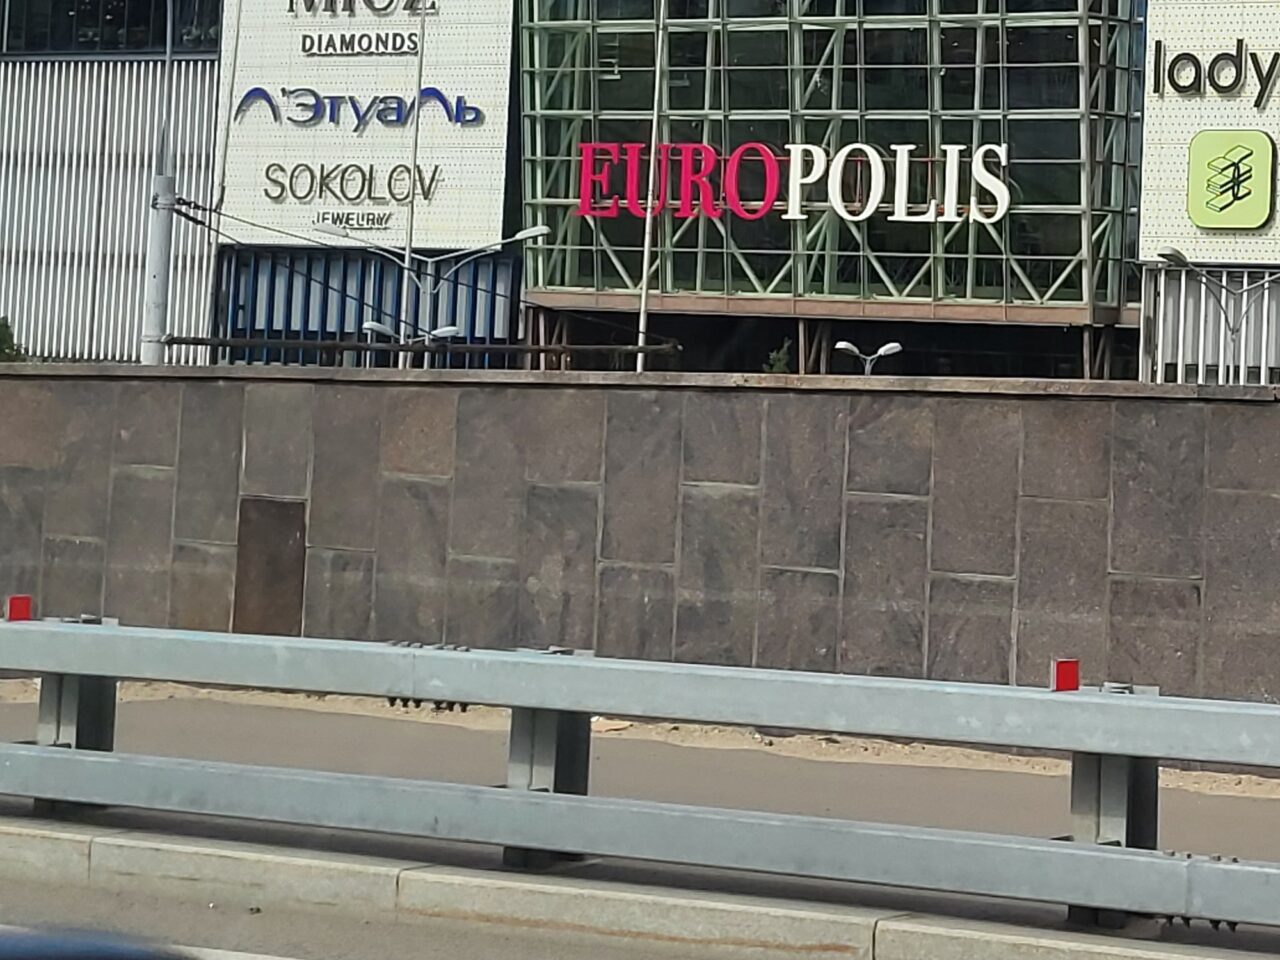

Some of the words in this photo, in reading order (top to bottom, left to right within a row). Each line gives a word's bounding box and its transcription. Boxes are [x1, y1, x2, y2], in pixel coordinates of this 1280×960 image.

[301, 32, 420, 55] DIAMONDS
[263, 162, 441, 203] SOKOLOV
[573, 141, 1013, 225] EUROPOLIS
[311, 211, 394, 228] JEWELRY
